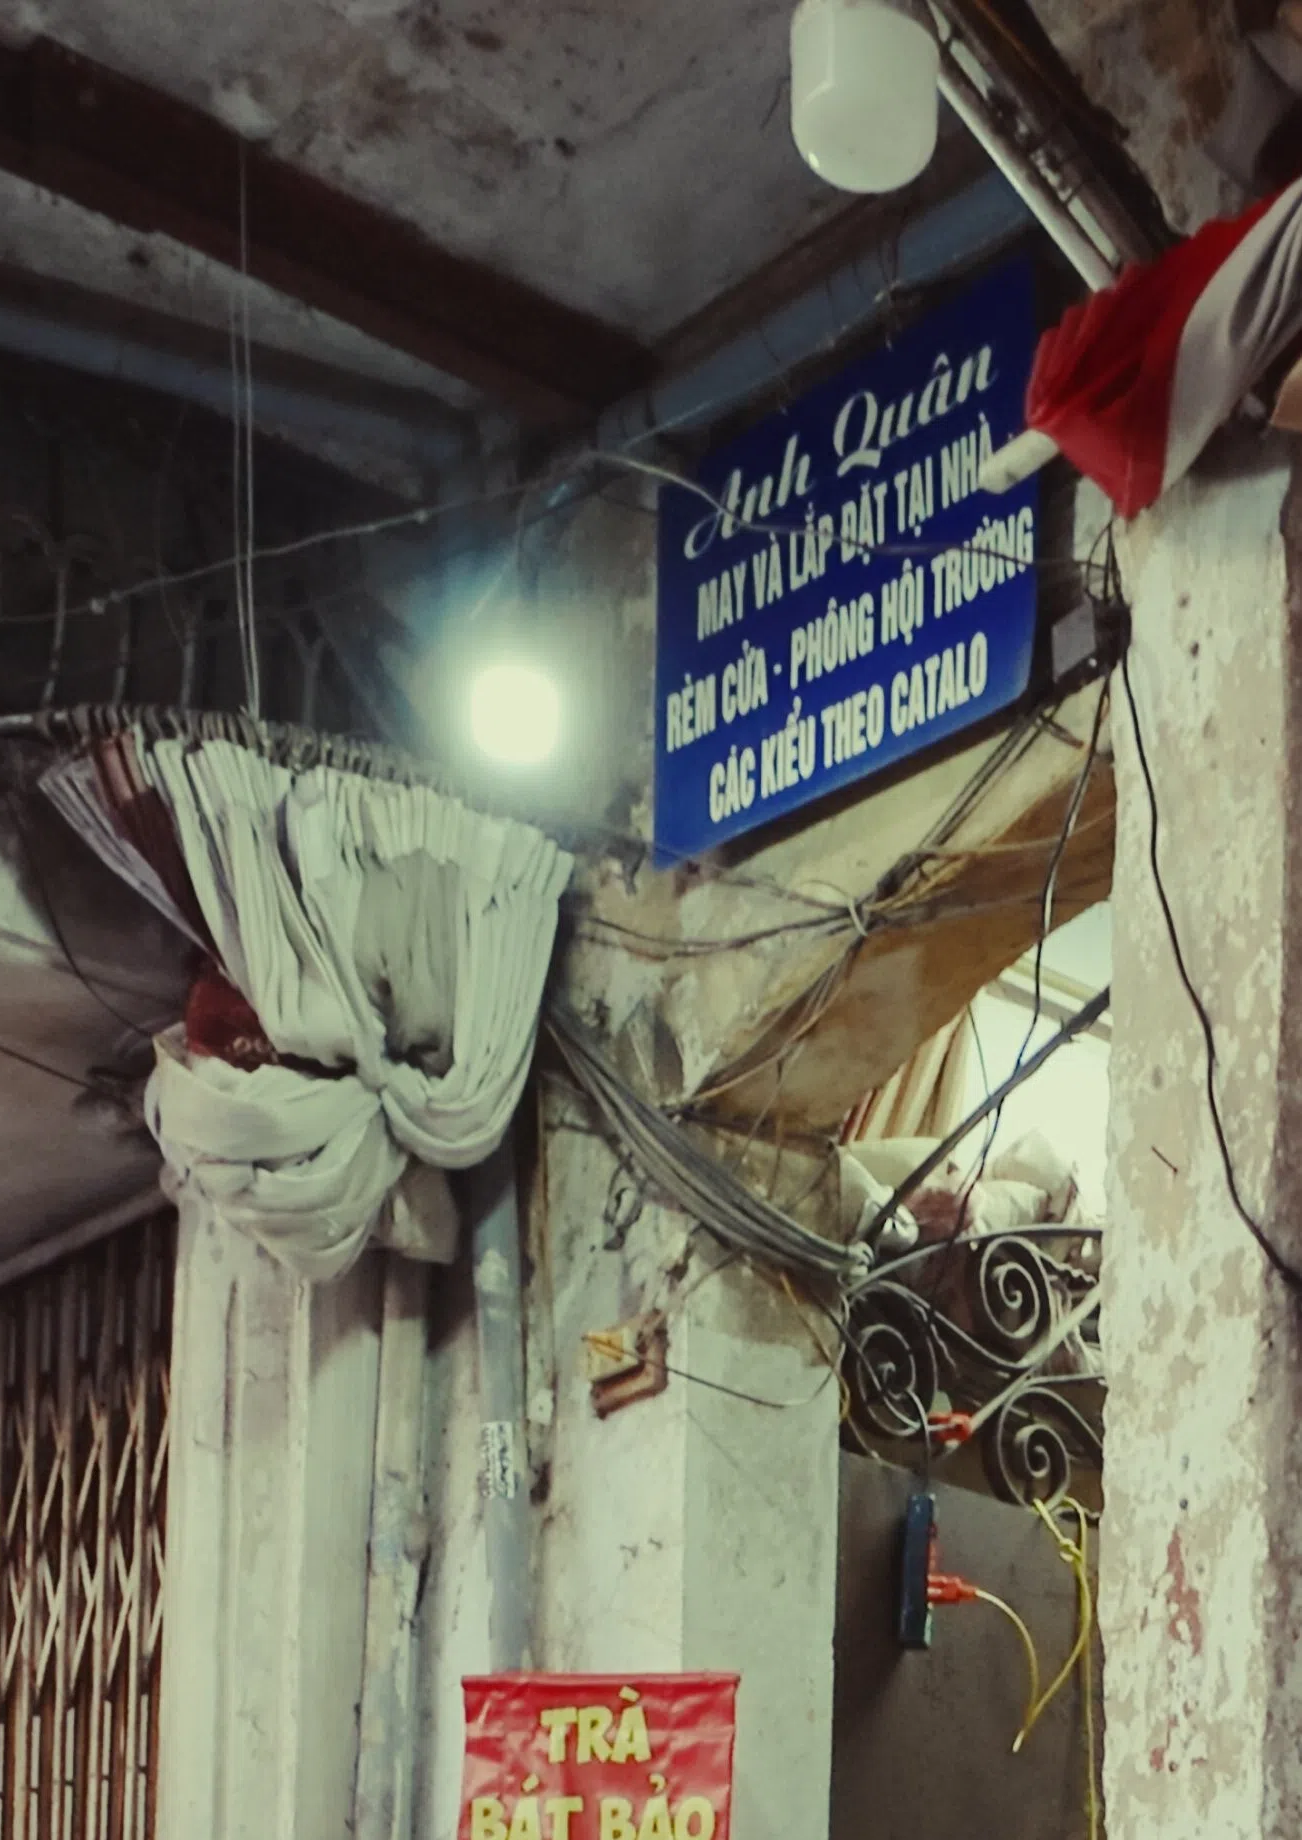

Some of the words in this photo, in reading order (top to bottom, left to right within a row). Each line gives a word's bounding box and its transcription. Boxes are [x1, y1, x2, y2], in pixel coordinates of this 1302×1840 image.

[684, 435, 812, 559] Anh
[832, 343, 998, 476] Quân
[667, 673, 715, 752] RÈM
[722, 640, 768, 722] CỬA
[881, 558, 924, 646] HỘI
[931, 505, 1033, 615] TRƯỜNG
[698, 558, 746, 640] MAY
[752, 532, 783, 609] VÀ
[789, 503, 832, 591] LẮP
[839, 480, 887, 565] ĐẶT
[894, 455, 934, 538] TẠI
[709, 733, 756, 823] CÁC
[760, 695, 816, 799] KIỂU
[822, 687, 883, 769] THEO
[891, 631, 988, 735] CATALO
[540, 1685, 652, 1765] TRÀ
